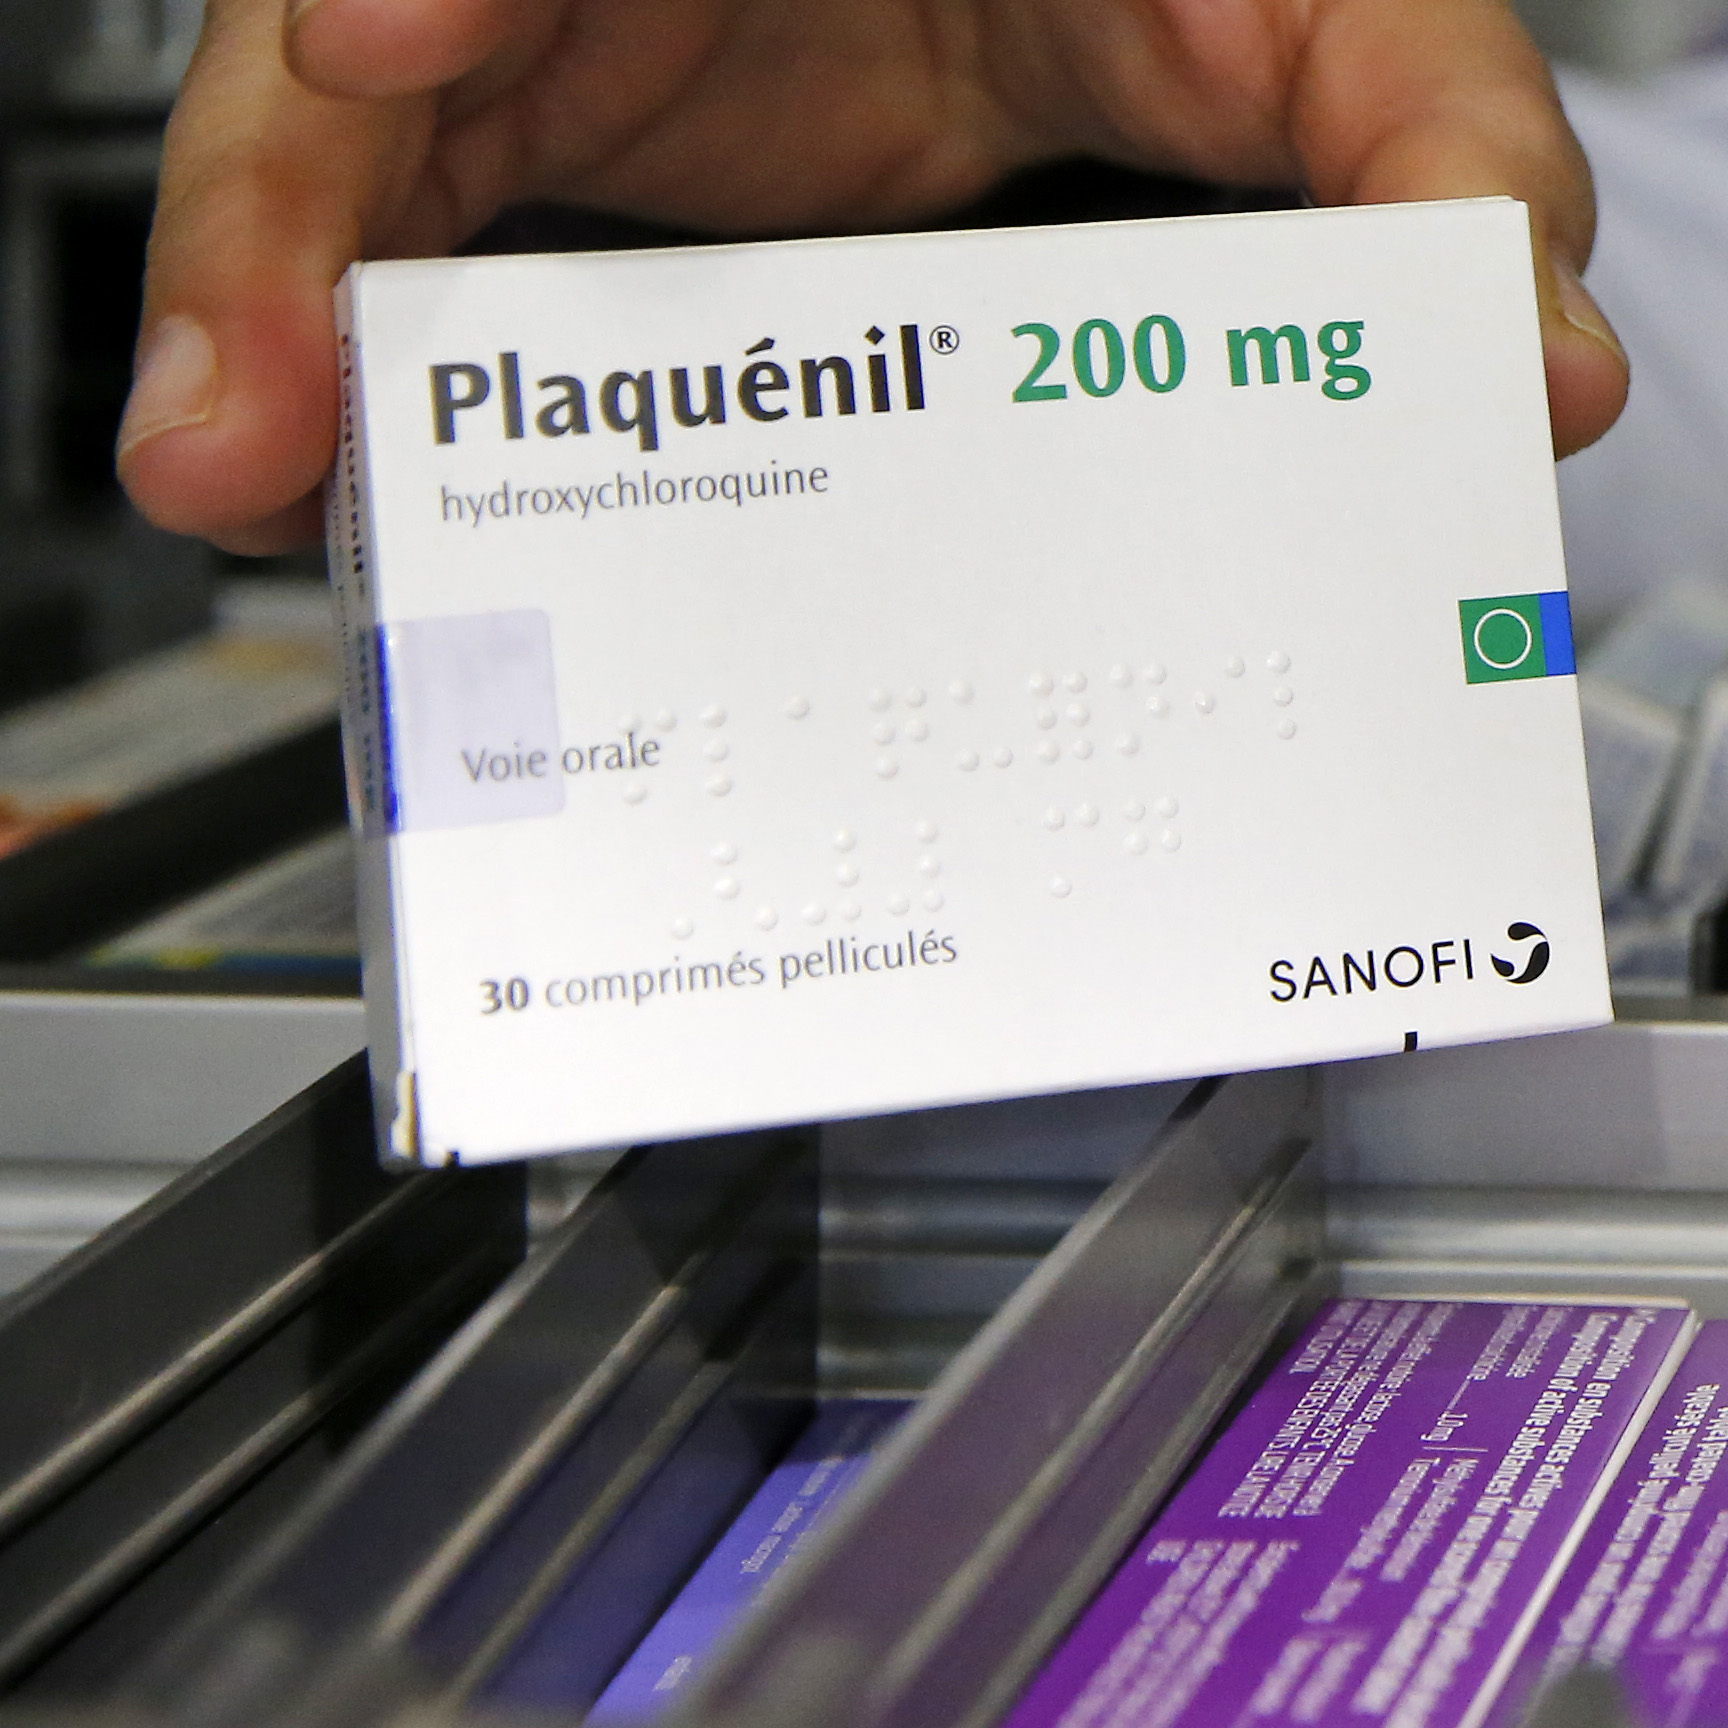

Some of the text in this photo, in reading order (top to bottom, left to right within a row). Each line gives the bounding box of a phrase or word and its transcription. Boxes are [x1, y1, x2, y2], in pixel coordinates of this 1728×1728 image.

[1011, 314, 1187, 405] 200
[1225, 317, 1373, 403] mg
[440, 459, 829, 526] hydroxychloroquine
[462, 732, 662, 784] Voie orale
[478, 927, 958, 1014] 30 comprimés pelliculés
[1269, 940, 1475, 1003] SANOFI
[1520, 1391, 1574, 1425] active
[1543, 1378, 1584, 1391] of
[1578, 1382, 1611, 1397] en
[1479, 1426, 1556, 1494] substances
[1540, 1398, 1611, 1462] substances
[1512, 1464, 1575, 1508] actives
